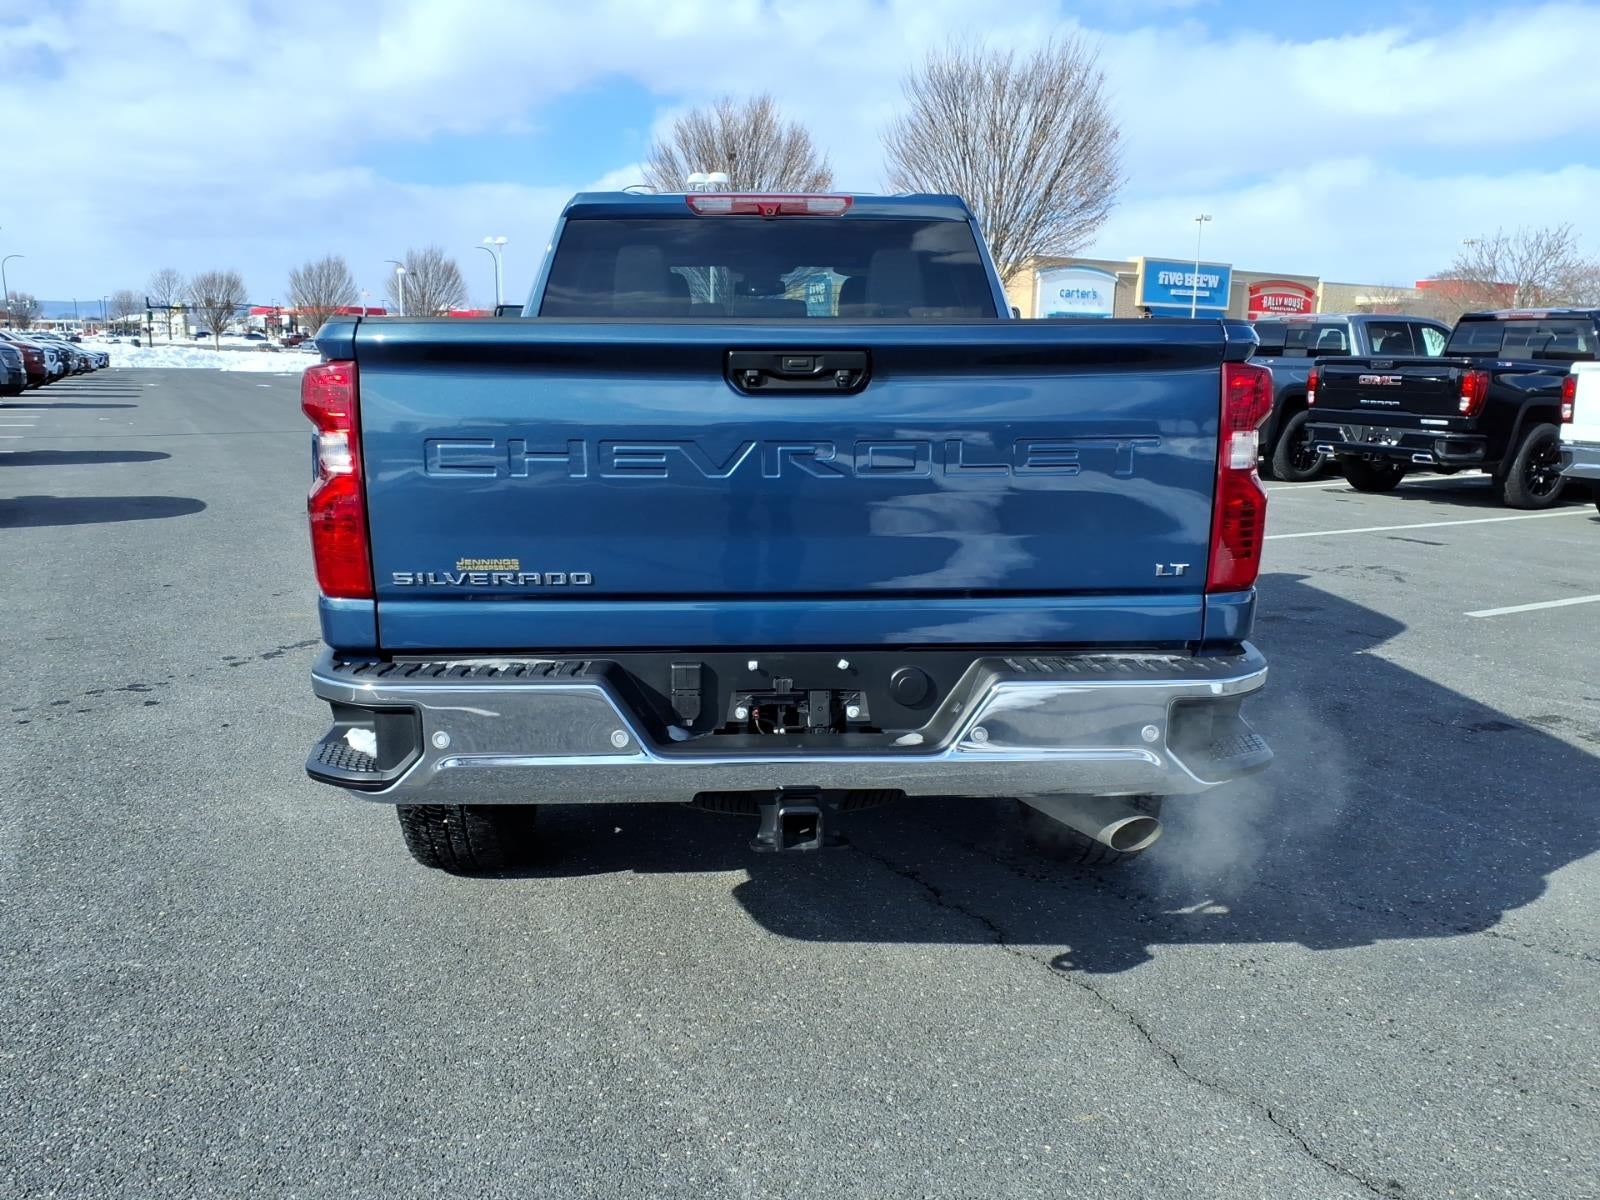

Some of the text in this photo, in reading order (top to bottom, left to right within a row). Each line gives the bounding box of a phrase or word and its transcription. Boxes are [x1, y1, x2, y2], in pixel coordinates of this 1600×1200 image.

[1158, 271, 1219, 288] five BELOW
[1059, 288, 1098, 300] carter's
[1262, 295, 1304, 310] RALLY HOUSE
[1358, 374, 1402, 386] GMC
[424, 436, 1161, 479] CHEVROLET
[456, 557, 520, 565] JENNINGS
[1155, 562, 1190, 576] LT
[392, 572, 592, 585] SILVERADO
